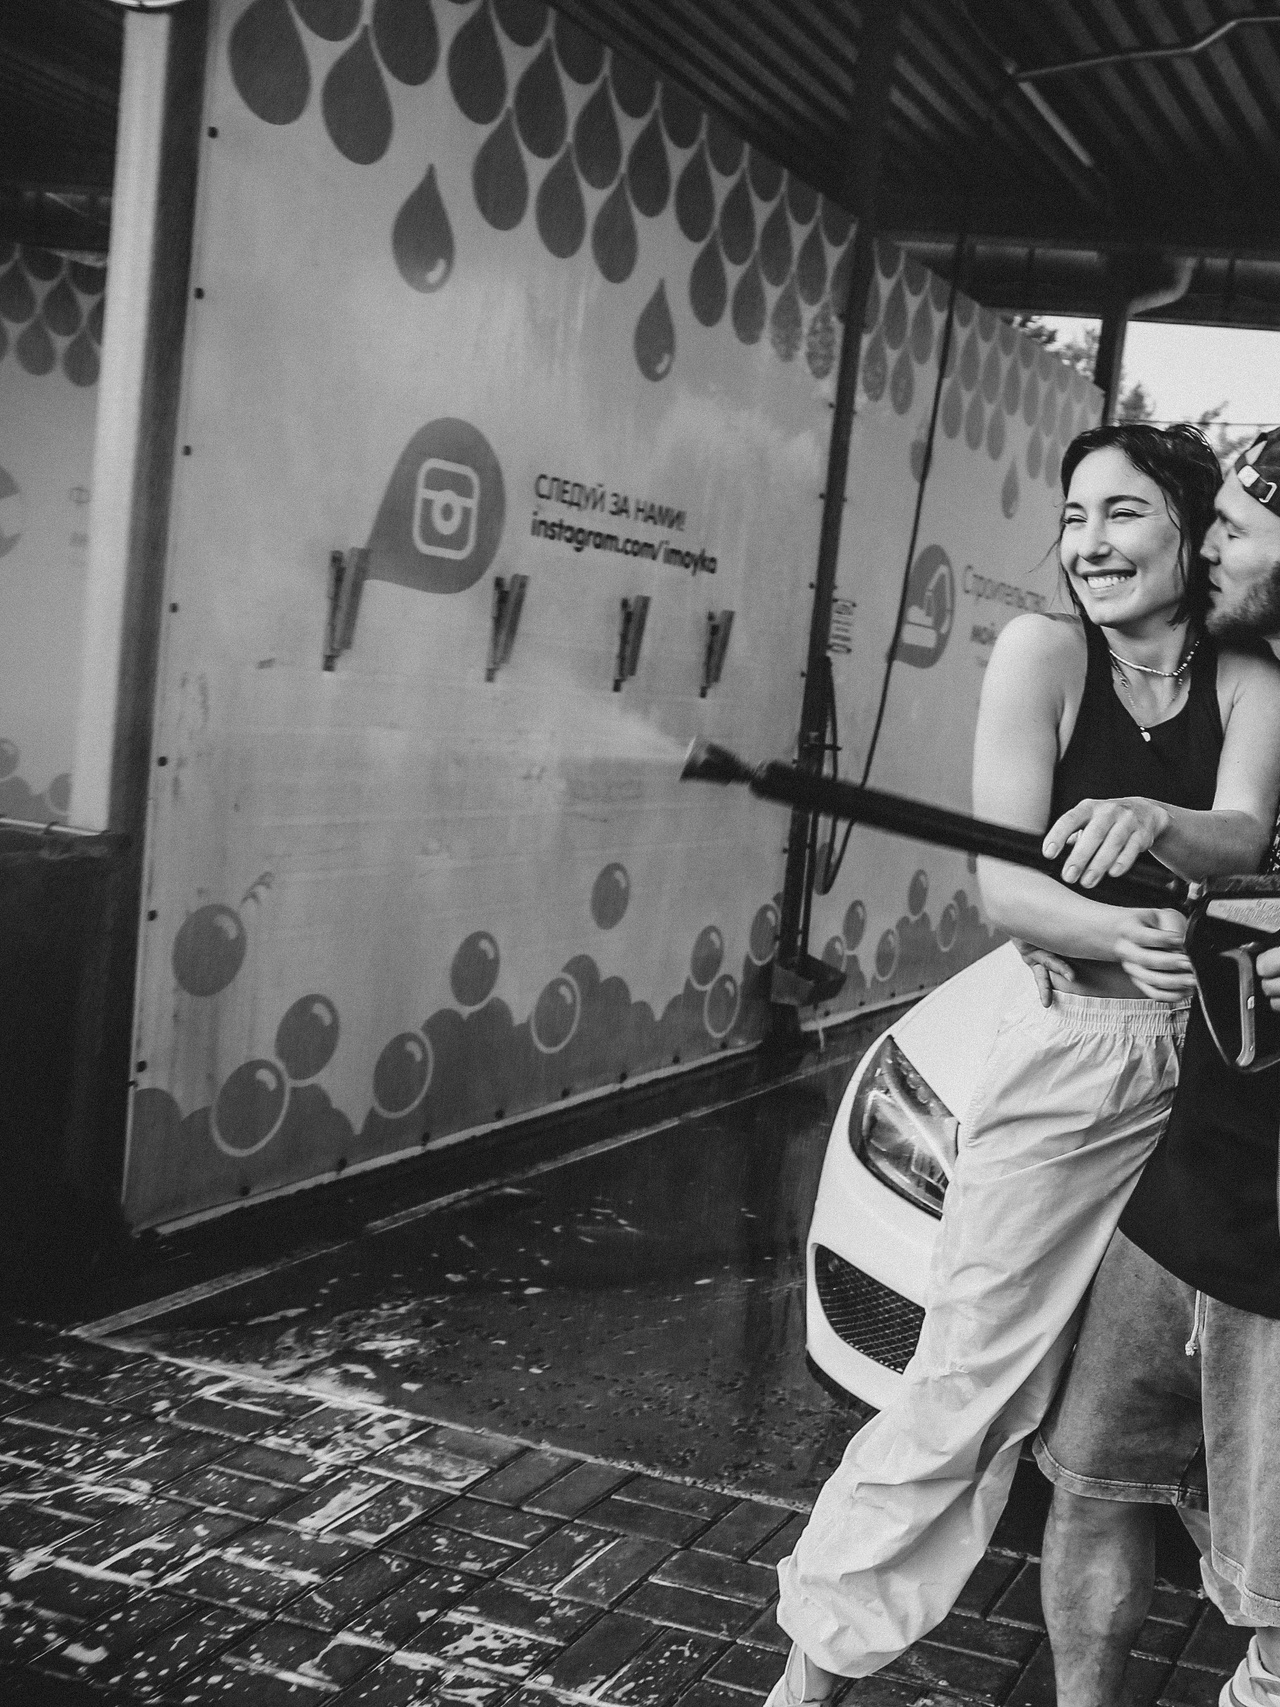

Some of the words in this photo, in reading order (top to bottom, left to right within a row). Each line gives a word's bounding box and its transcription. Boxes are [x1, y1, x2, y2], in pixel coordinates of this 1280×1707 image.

[534, 474, 606, 512] СЛЕДУЙ
[609, 493, 630, 519] ЗА
[531, 510, 718, 576] instagram.com/imoyka
